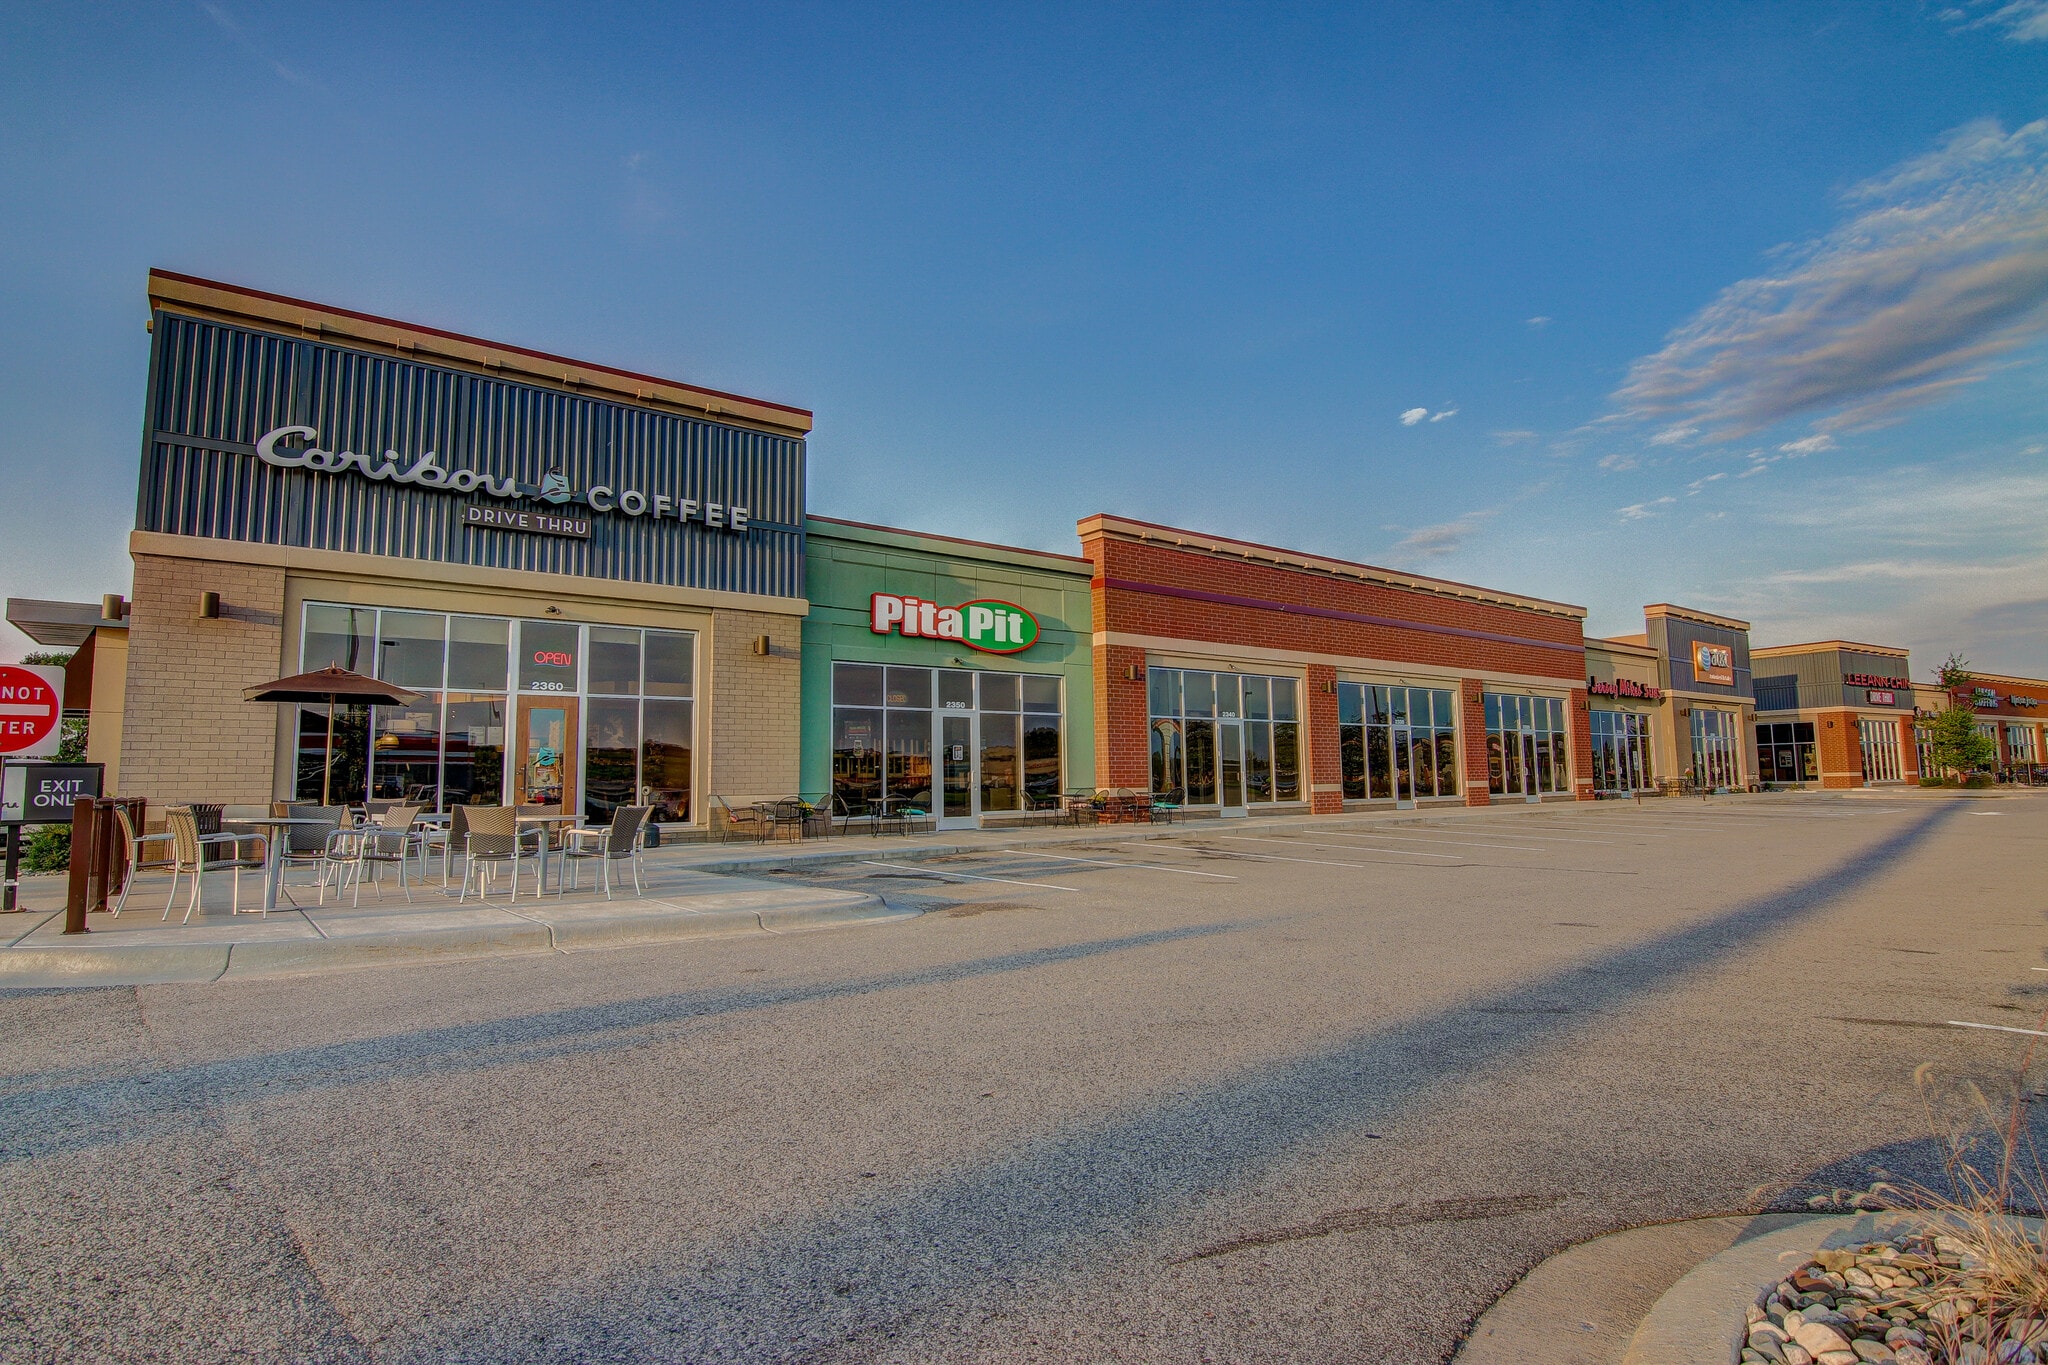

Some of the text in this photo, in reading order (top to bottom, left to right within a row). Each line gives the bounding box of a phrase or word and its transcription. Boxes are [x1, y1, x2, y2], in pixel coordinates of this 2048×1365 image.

[256, 425, 749, 532] Caribou COFFEE
[468, 507, 586, 534] DRIVE THRU
[874, 594, 1024, 644] Pita Pit
[533, 651, 572, 666] OPEN
[531, 681, 564, 691] 2360
[1848, 673, 1889, 688] LEEANN
[2, 686, 44, 700] NOT
[946, 701, 966, 709] 2350
[40, 779, 84, 793] EXIT
[33, 794, 79, 807] ONL
